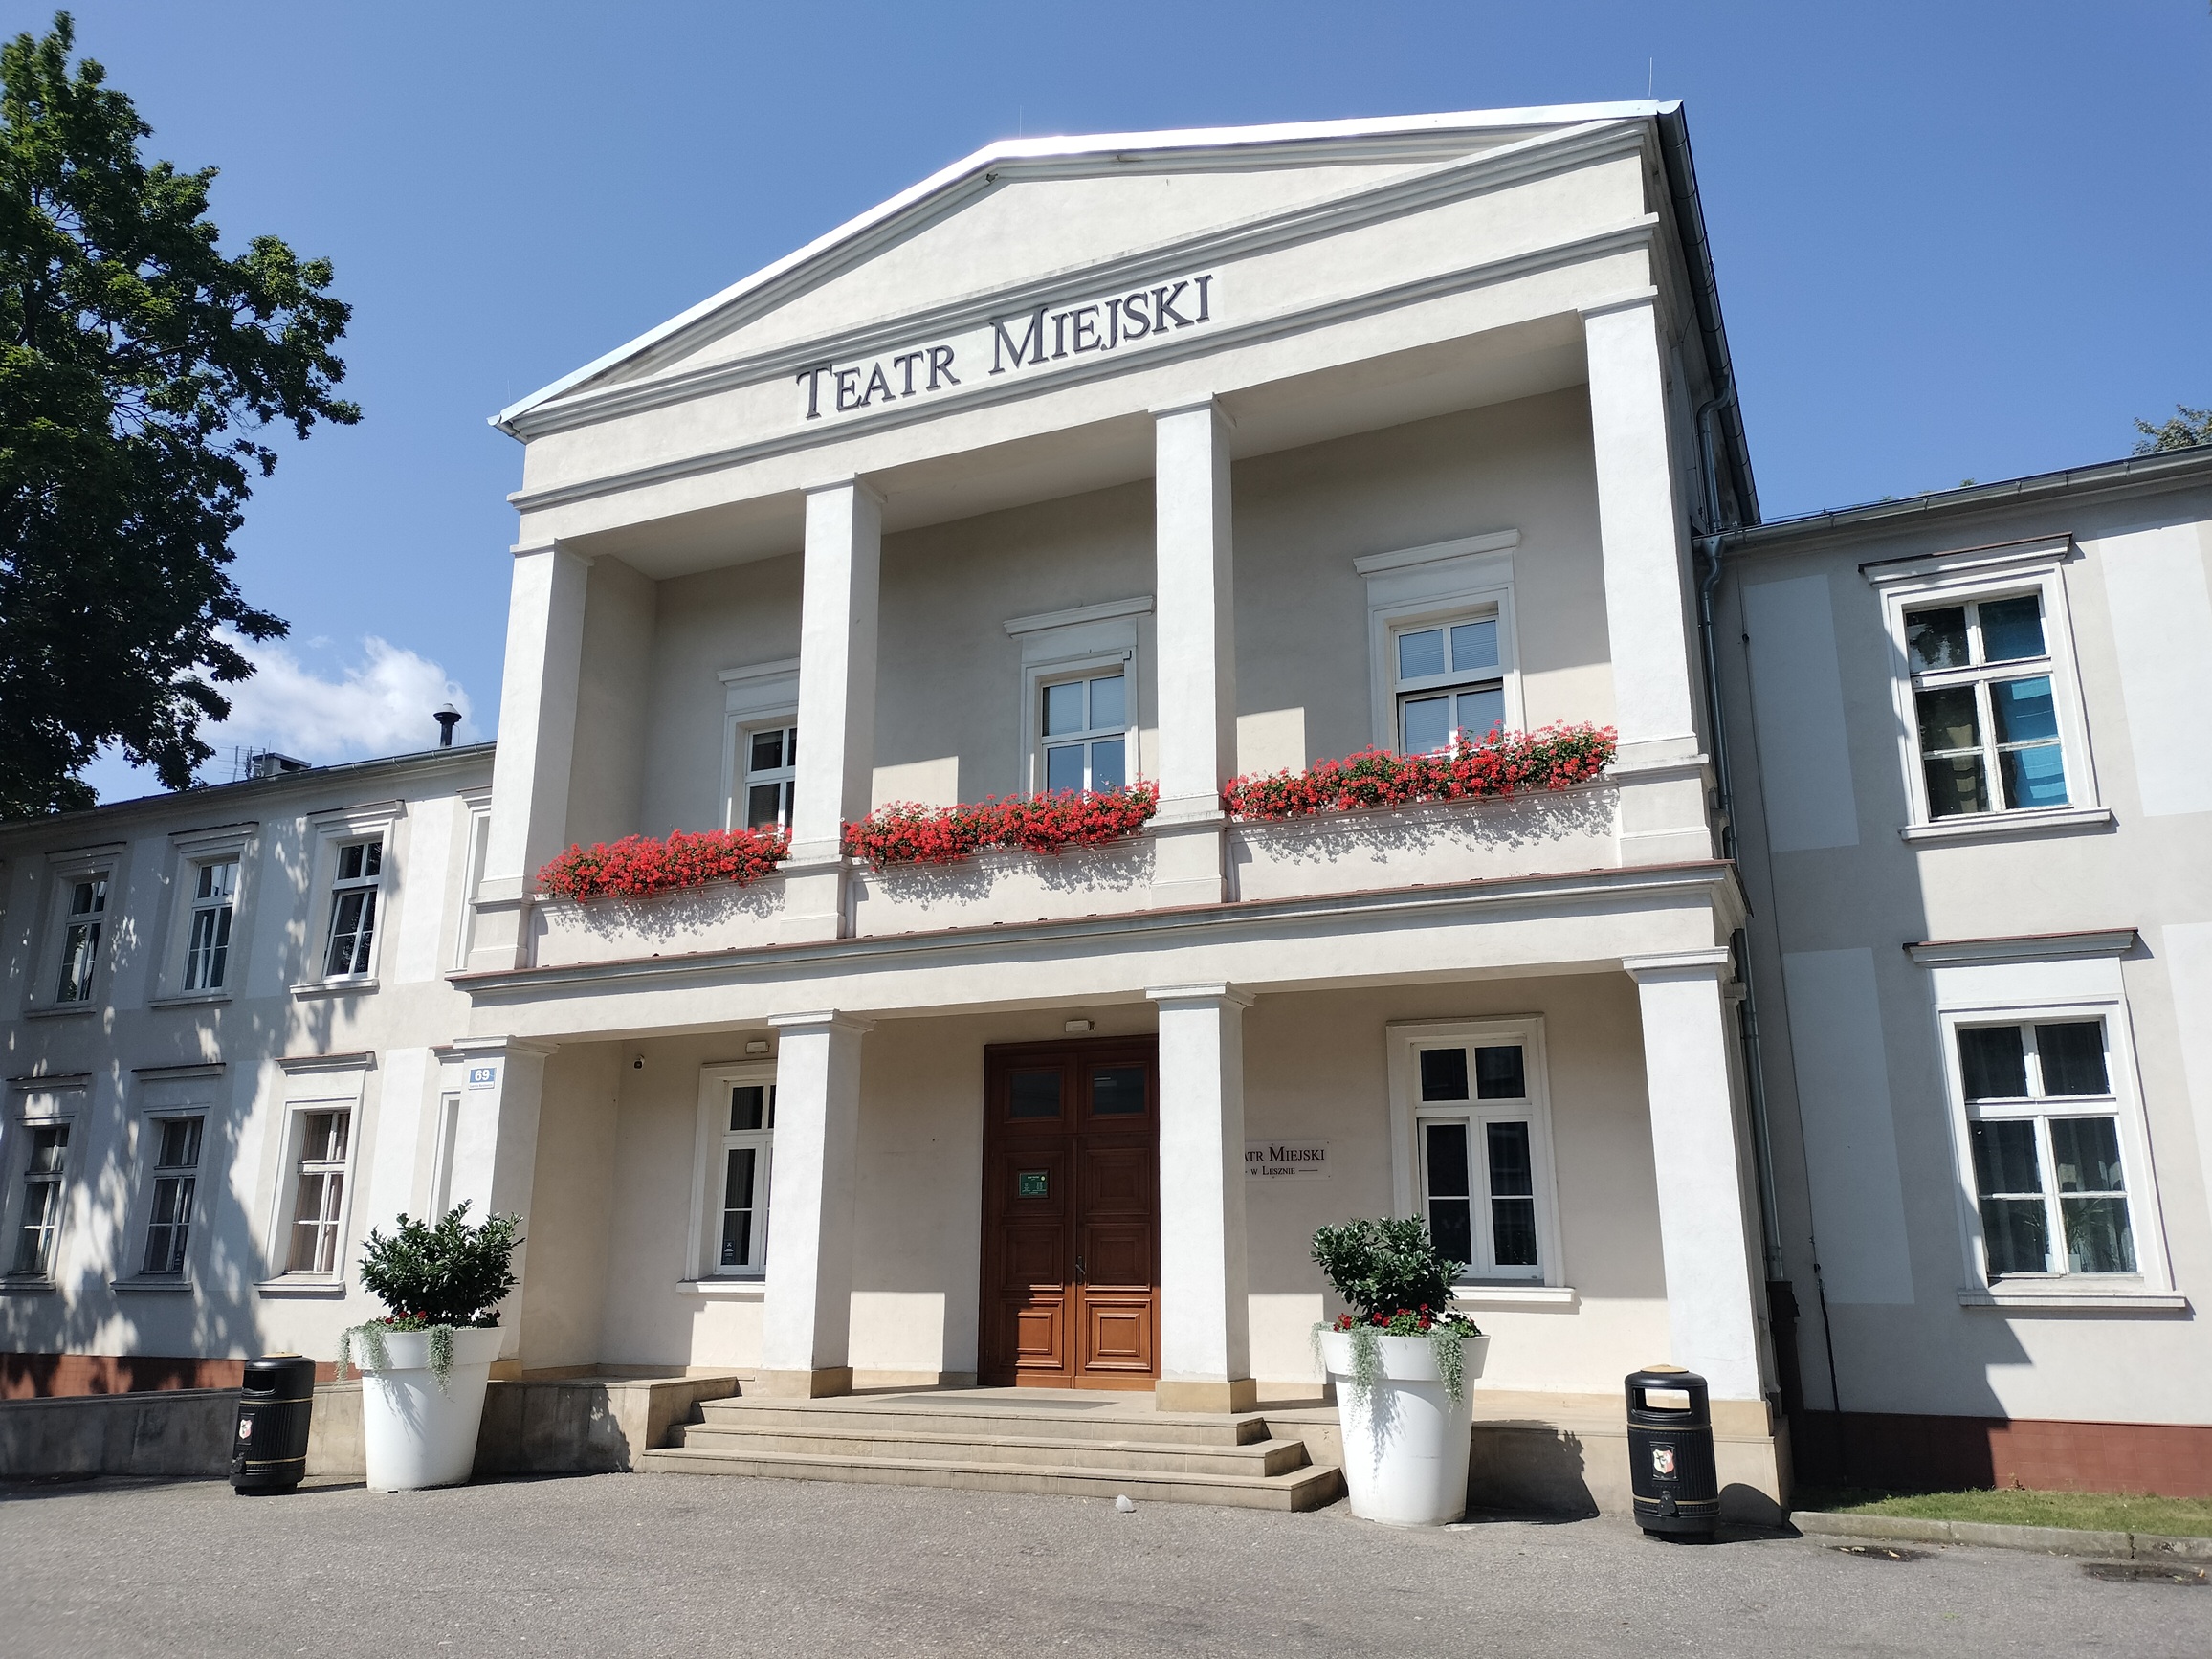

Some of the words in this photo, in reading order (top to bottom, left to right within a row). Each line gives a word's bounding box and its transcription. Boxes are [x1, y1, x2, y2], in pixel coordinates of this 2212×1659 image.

[796, 344, 961, 420] TEATR
[988, 274, 1213, 374] MIEJSKI
[475, 1069, 490, 1081] 69
[1269, 1146, 1325, 1161] MIEJSKI
[1262, 1165, 1295, 1176] LESZNIE
